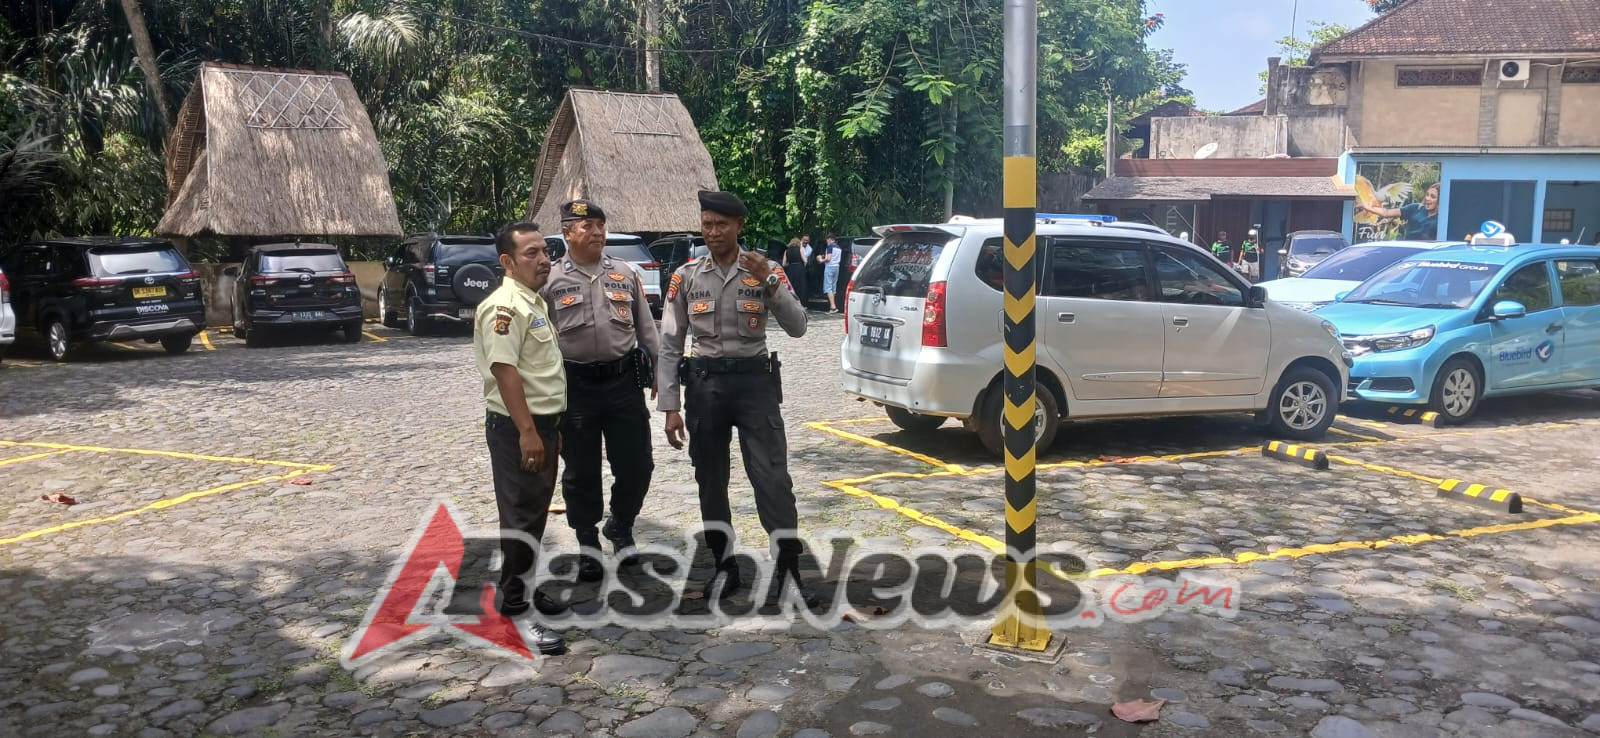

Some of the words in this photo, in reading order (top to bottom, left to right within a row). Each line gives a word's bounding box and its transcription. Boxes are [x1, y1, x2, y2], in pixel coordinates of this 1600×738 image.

[463, 278, 489, 290] Jeep
[604, 282, 630, 290] POLRI
[1499, 348, 1532, 361] Bluebird
